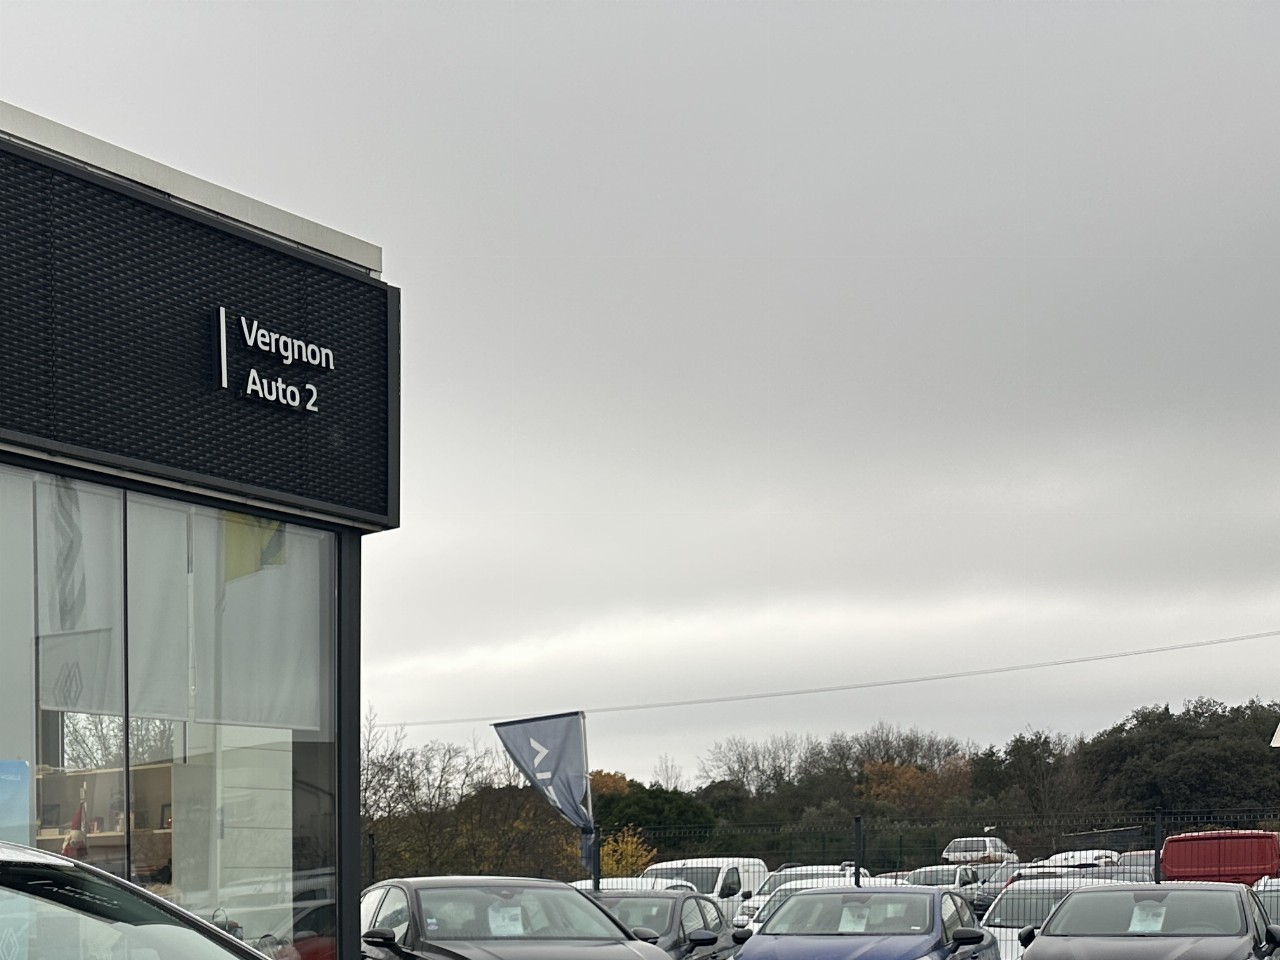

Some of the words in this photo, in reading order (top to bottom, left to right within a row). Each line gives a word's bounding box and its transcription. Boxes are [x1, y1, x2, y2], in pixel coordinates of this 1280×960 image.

[240, 316, 335, 370] Vergnon
[246, 368, 301, 407] Auto
[305, 383, 319, 412] 2
